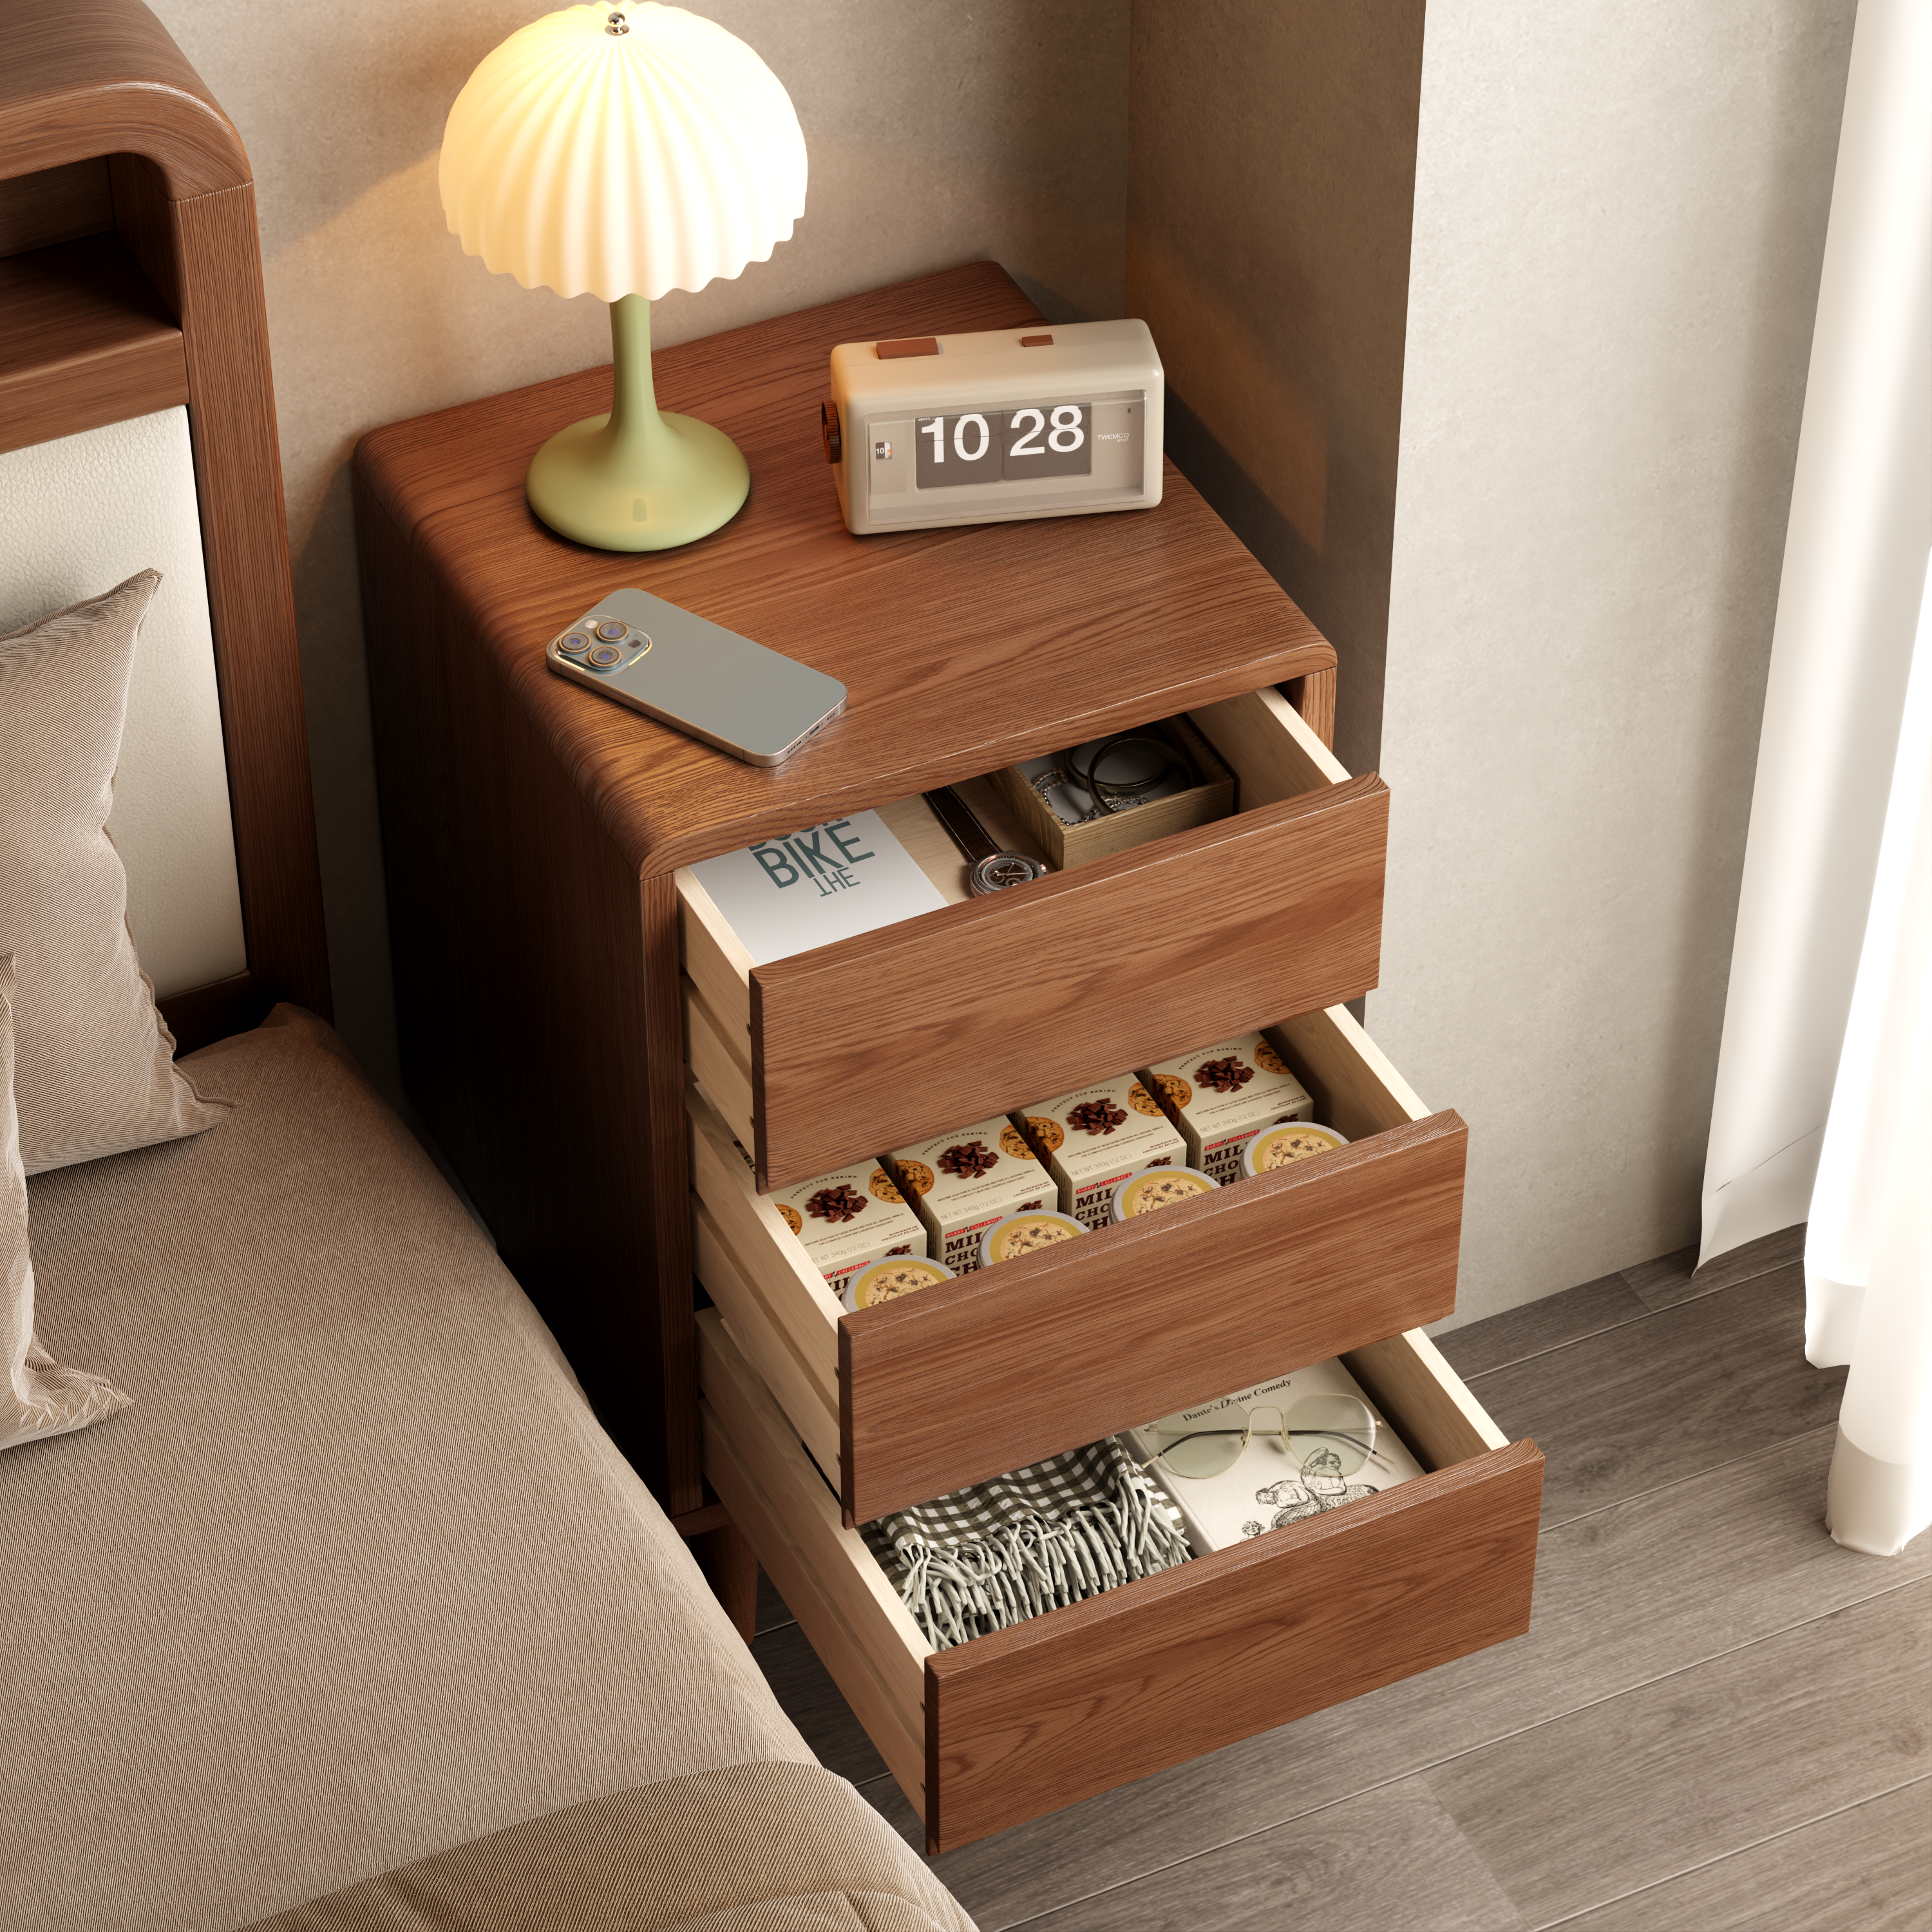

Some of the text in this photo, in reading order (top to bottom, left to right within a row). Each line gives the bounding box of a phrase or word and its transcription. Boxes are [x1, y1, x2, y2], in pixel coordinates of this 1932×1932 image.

[922, 405, 1084, 463] 10 28
[752, 820, 875, 889] BIKE
[1179, 1055, 1200, 1070] PERFECT
[1052, 1097, 1073, 1112] PERFECT
[1221, 1117, 1237, 1126] 340g
[922, 1139, 944, 1155] PERFECT
[1204, 1144, 1244, 1166] MIL
[1071, 1168, 1083, 1177] NET
[1093, 1160, 1110, 1170] 340g
[791, 1183, 813, 1199] PERFECT
[1075, 1188, 1113, 1209] MIL
[962, 1204, 979, 1214] 340g
[945, 1231, 982, 1253] MIL
[829, 1248, 847, 1258] 340g
[846, 1245, 857, 1253] (12
[1182, 1379, 1291, 1421] Dante's Dvine Comedy
